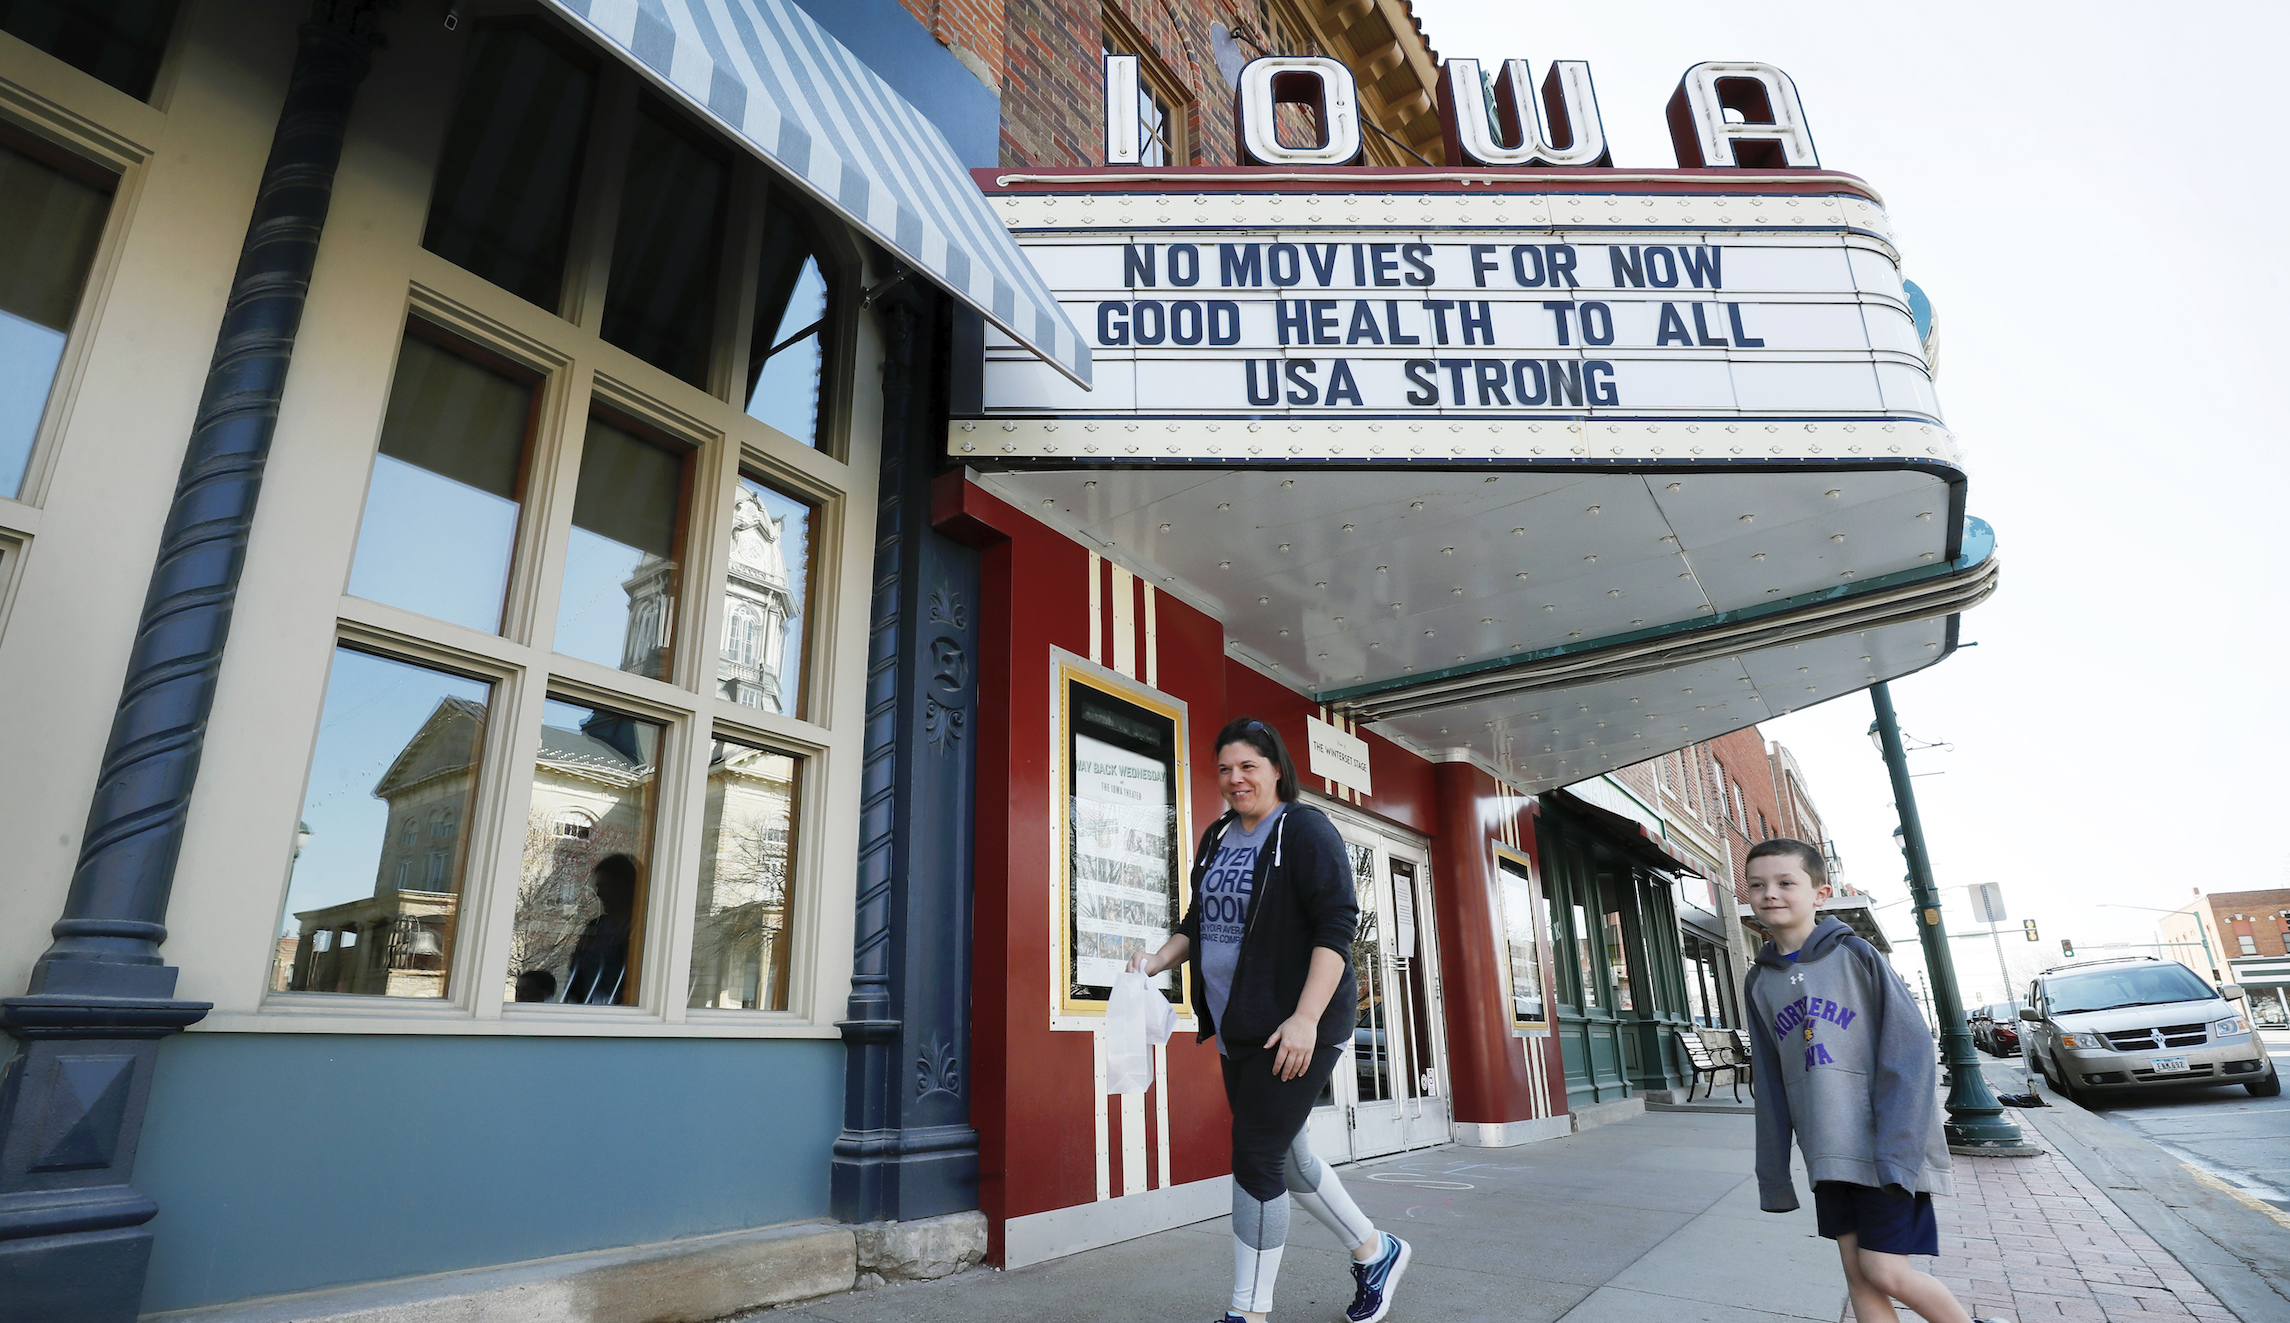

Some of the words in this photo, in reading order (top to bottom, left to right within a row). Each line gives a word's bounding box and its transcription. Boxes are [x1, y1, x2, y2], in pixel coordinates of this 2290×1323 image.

[1104, 54, 1821, 169] IOWA
[1124, 243, 1200, 287] NO
[1220, 243, 1436, 287] MOVIES
[1470, 244, 1579, 288] FOR
[1609, 245, 1722, 289] NOW
[1097, 301, 1241, 346] GOOD
[1276, 301, 1495, 346] HEALTH
[1543, 301, 1614, 347] TO
[1656, 302, 1765, 347] ALL
[1244, 358, 1364, 406] USA
[1404, 358, 1620, 407] STRONG
[1093, 762, 1118, 776] BACK
[1119, 765, 1166, 782] WEDNESDAY
[1313, 740, 1324, 753] THE
[1324, 745, 1353, 766] WINTERSET
[1353, 758, 1367, 772] STAGE
[1101, 782, 1110, 792] THE
[1111, 784, 1123, 796] IOWA
[1124, 786, 1142, 801] THEATER
[1205, 869, 1254, 894] ORE
[1206, 924, 1222, 933] YOUR
